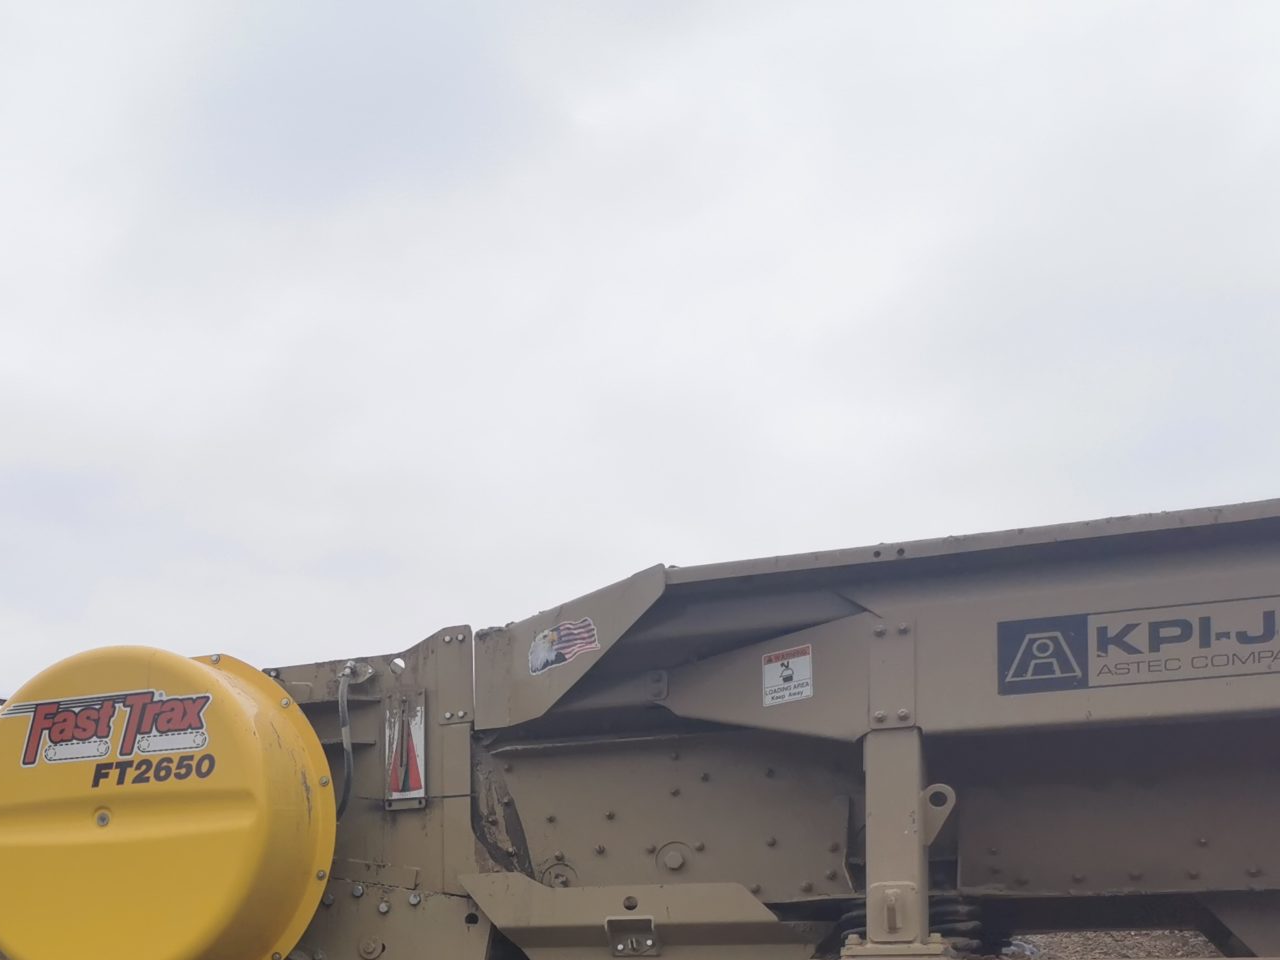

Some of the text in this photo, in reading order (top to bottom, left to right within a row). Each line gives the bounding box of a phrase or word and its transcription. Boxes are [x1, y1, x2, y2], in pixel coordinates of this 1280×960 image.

[1097, 657, 1182, 676] ASTEC
[793, 681, 809, 690] AREA
[22, 691, 210, 766] Fast Trax
[92, 754, 215, 787] FT2650
